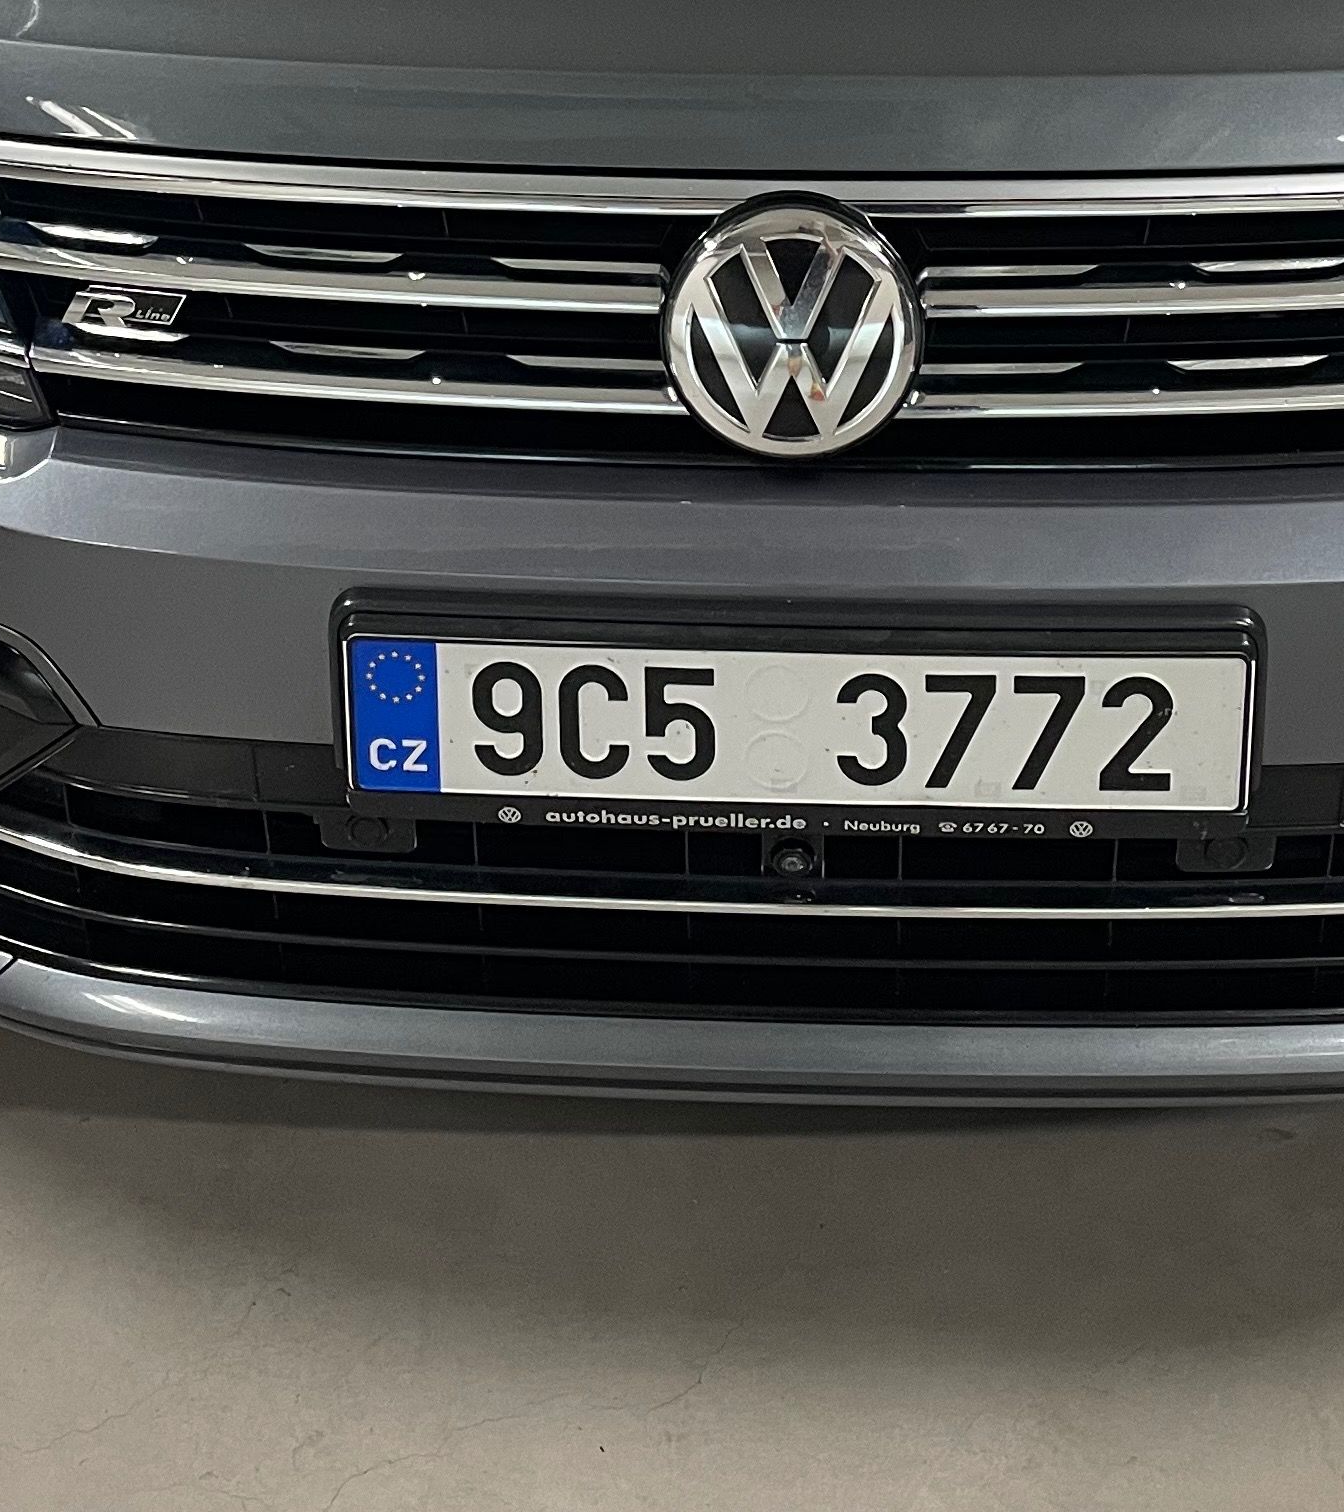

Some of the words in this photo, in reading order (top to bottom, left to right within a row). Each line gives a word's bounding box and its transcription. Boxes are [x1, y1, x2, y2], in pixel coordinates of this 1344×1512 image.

[471, 661, 716, 781] 9C5
[835, 672, 1172, 793] 3772
[369, 737, 429, 772] CZ
[545, 809, 807, 830] autohaus-prueller.de
[843, 820, 921, 835] Neuburg
